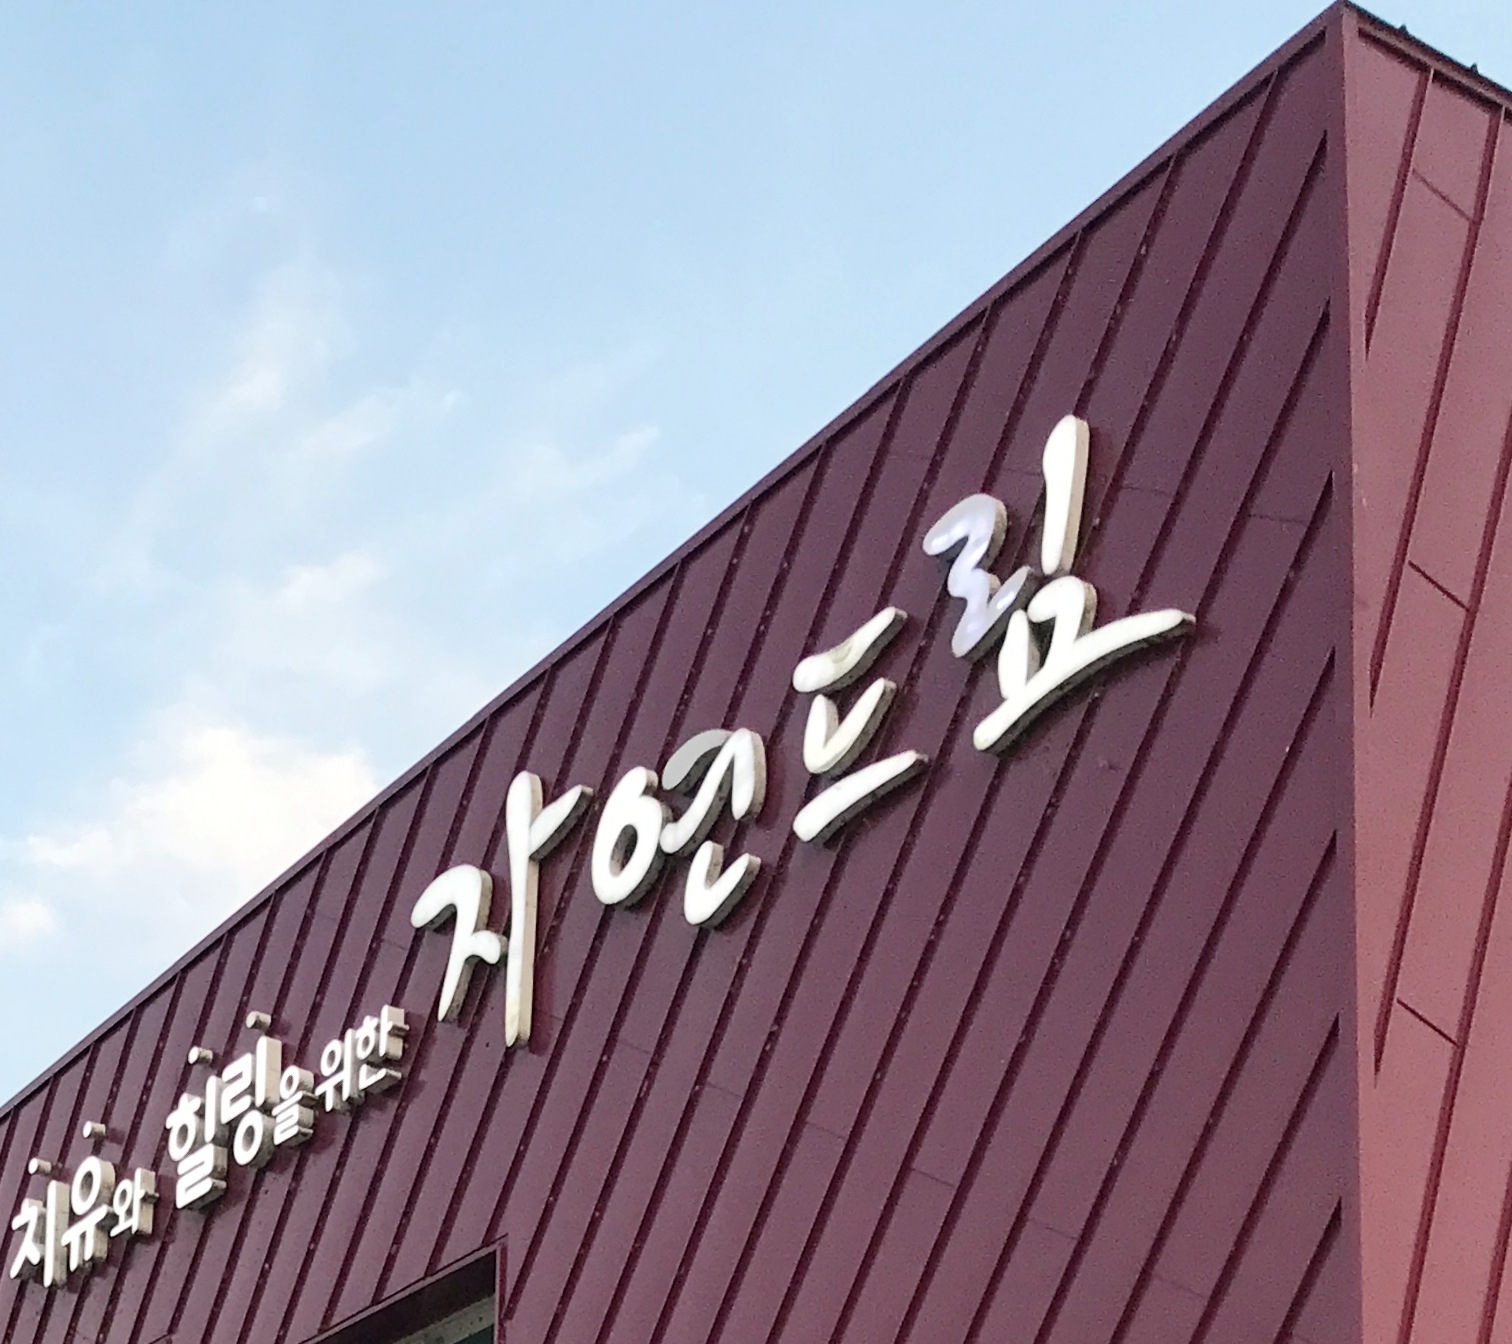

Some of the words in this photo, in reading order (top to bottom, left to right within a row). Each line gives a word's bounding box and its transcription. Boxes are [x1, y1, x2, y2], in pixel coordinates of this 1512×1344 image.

[10, 1153, 160, 1289] 치유와
[165, 1034, 316, 1210] 힐링을
[314, 1004, 410, 1113] 위한
[410, 414, 1196, 1050] 자연드림
